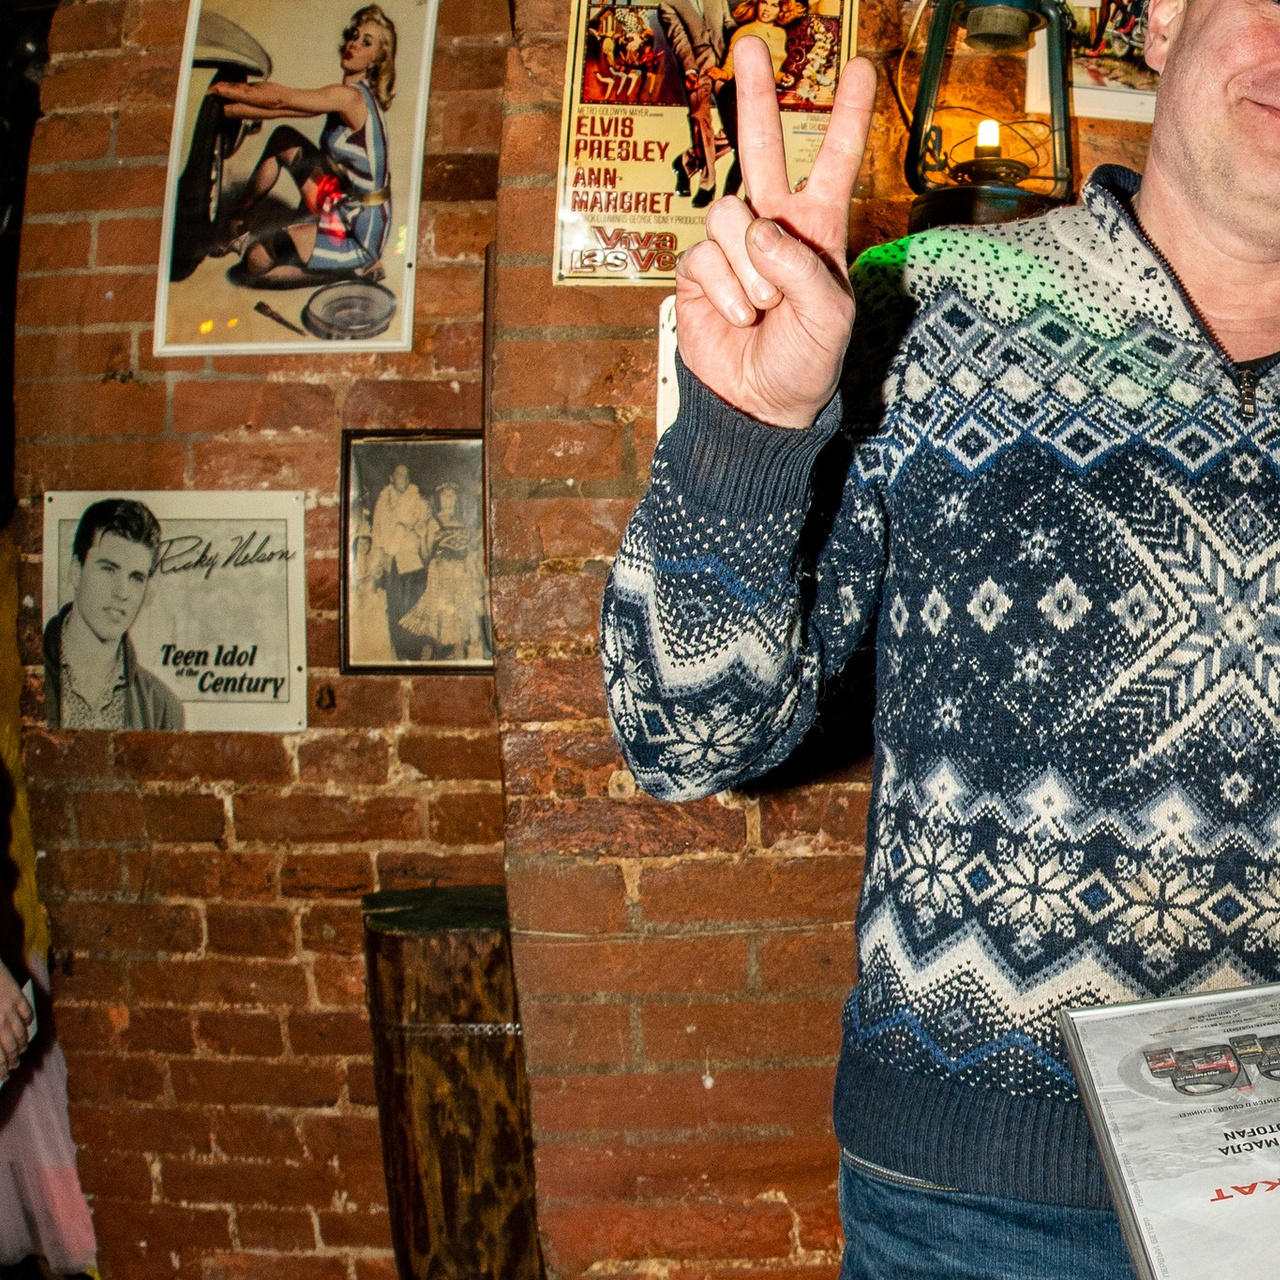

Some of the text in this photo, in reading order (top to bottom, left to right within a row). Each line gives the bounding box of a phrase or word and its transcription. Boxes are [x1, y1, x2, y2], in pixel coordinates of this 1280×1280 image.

[576, 116, 634, 138] ELVIS
[574, 139, 670, 162] PRESLEY
[572, 167, 622, 189] ANN-
[571, 191, 674, 214] MARGRET
[221, 530, 297, 569] Nelson
[161, 644, 258, 667] Teen Idol
[197, 671, 285, 699] Century
[1217, 1136, 1280, 1156] МАСЛА
